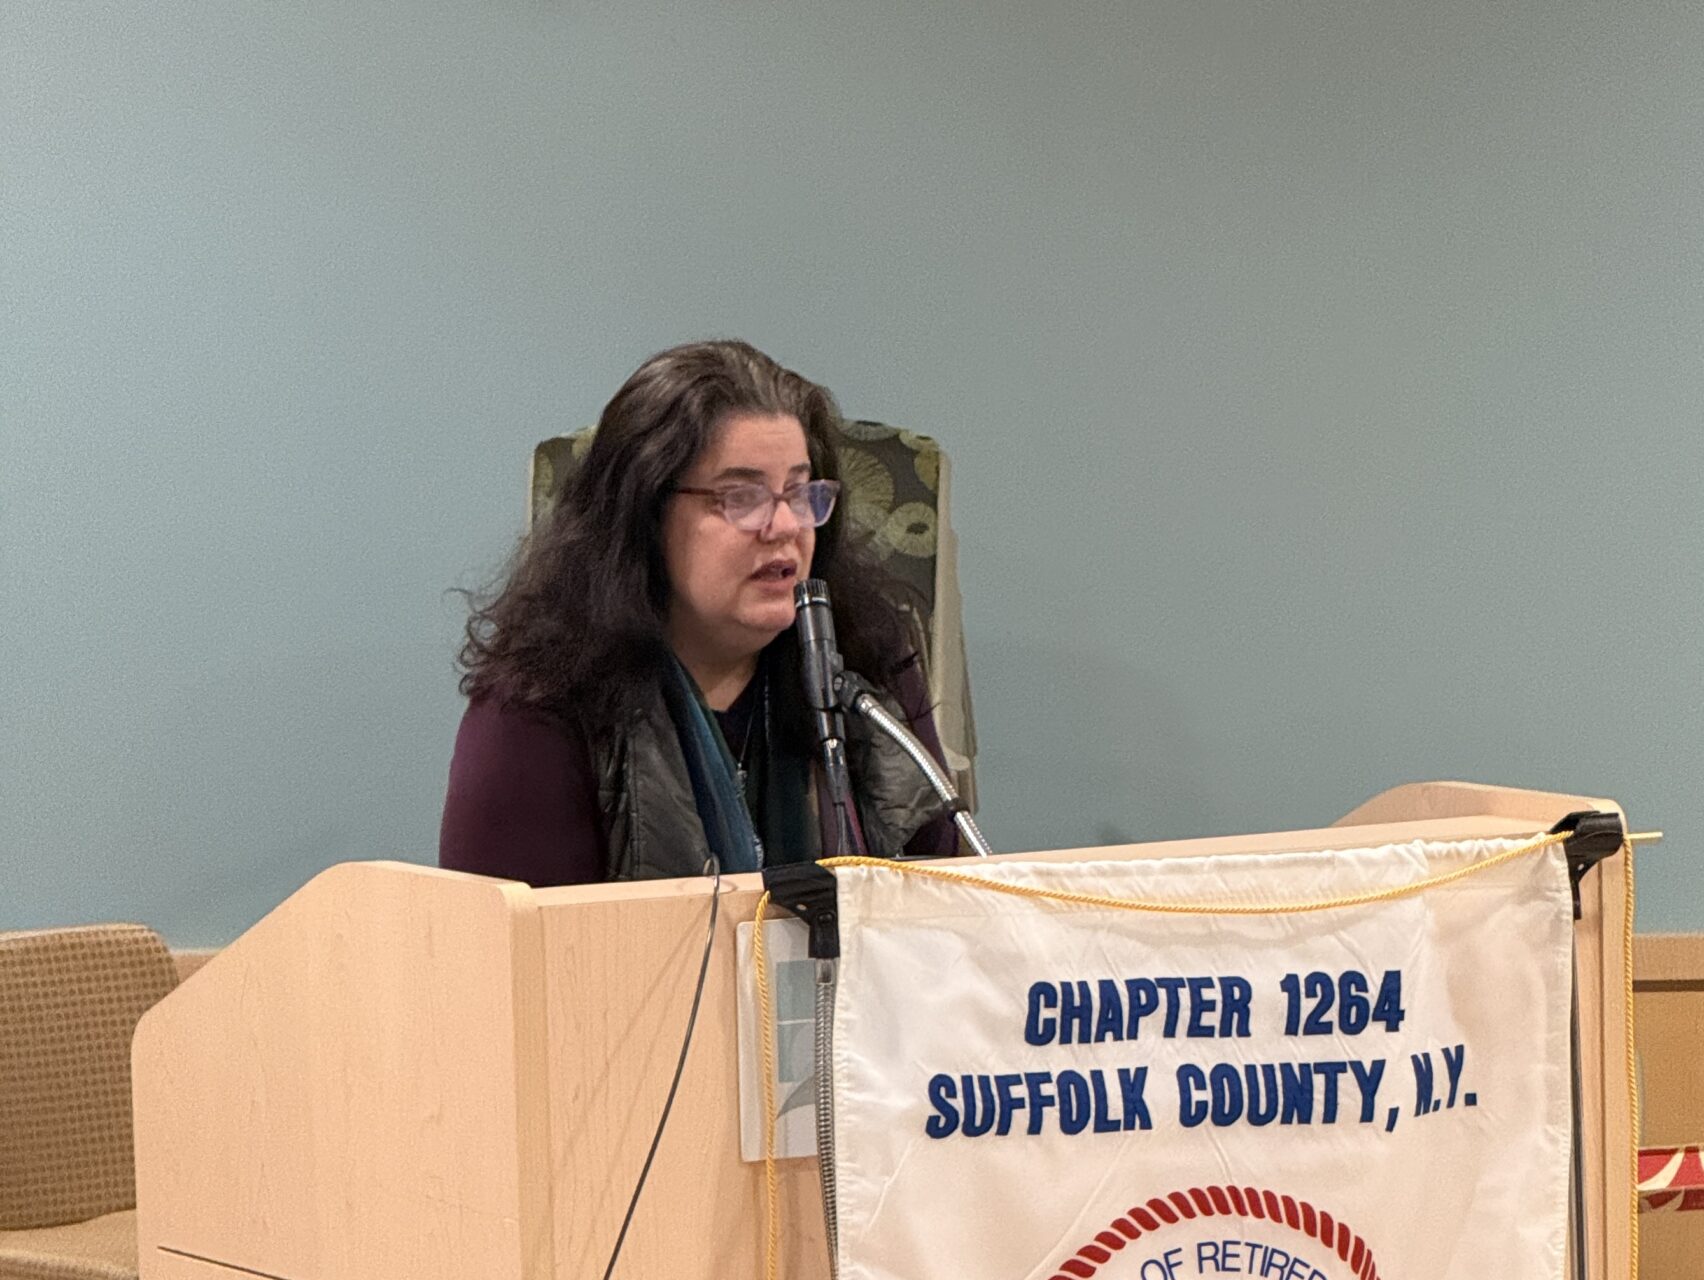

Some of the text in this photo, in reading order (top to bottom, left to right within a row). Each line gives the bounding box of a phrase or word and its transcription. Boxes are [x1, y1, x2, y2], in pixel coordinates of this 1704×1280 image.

[1024, 970, 1406, 1047] CHAPTER 1264
[926, 1044, 1478, 1139] SUFFOLK COUNTY, N.Y.
